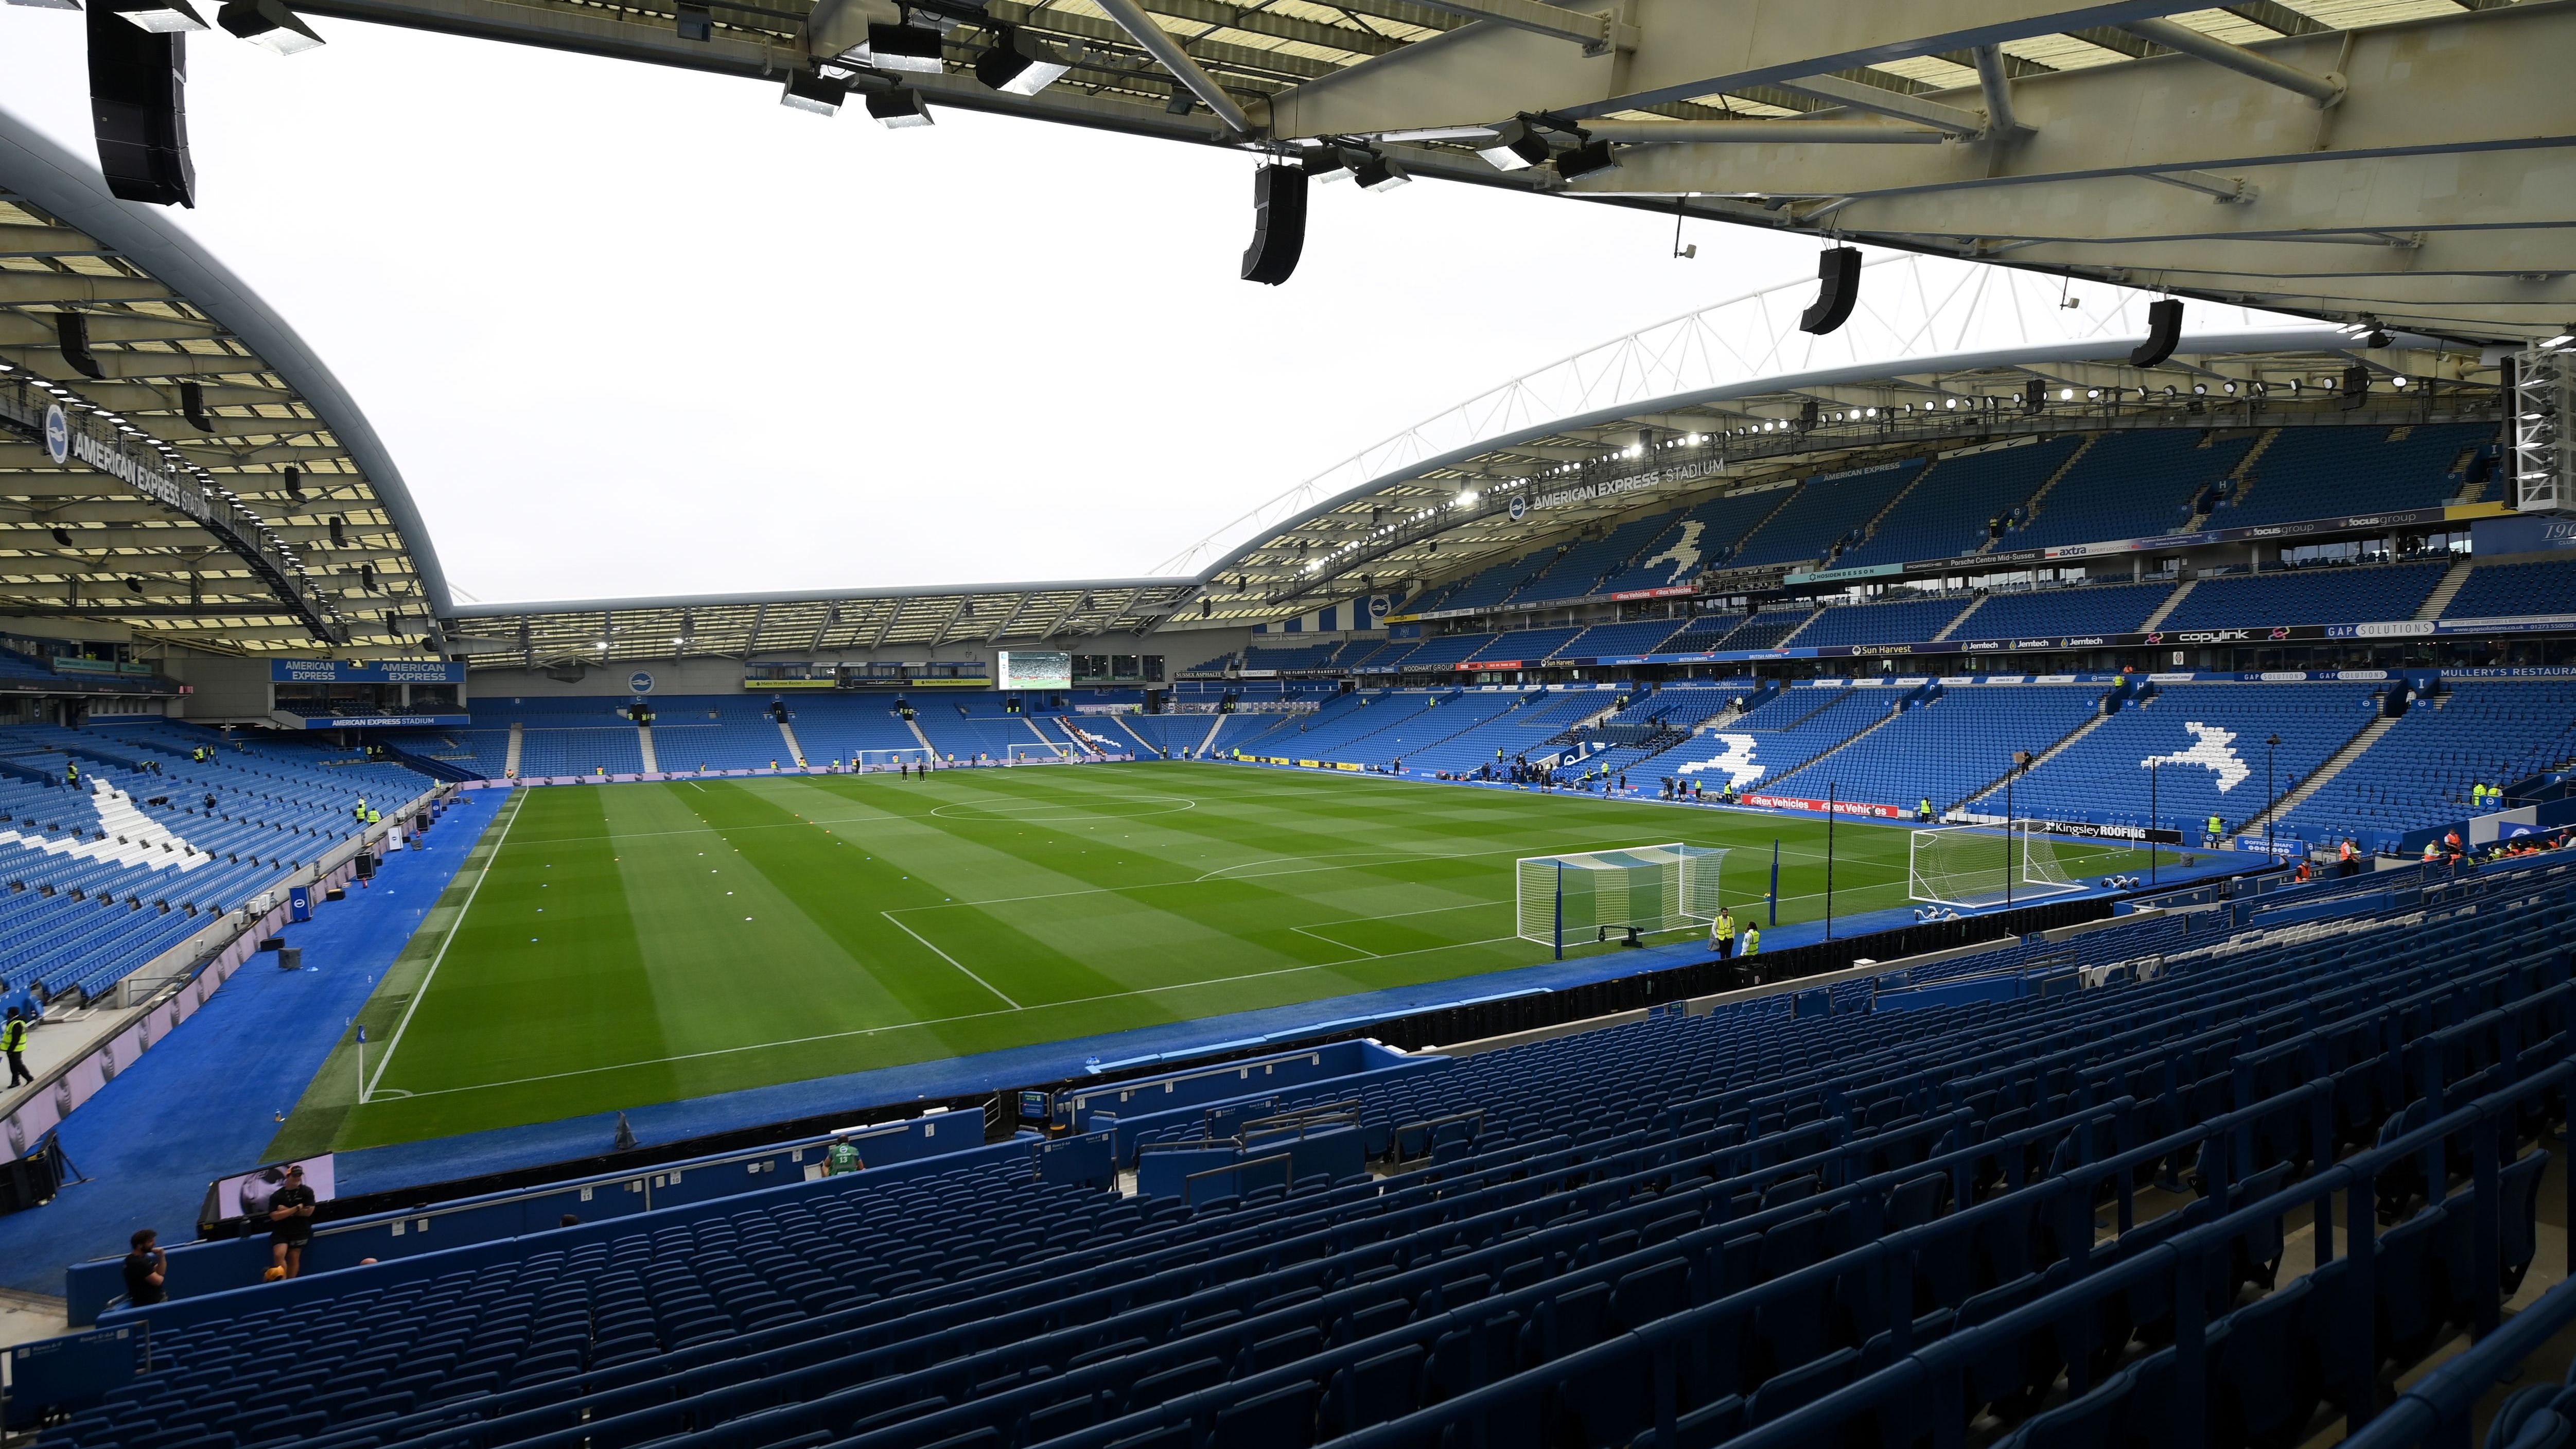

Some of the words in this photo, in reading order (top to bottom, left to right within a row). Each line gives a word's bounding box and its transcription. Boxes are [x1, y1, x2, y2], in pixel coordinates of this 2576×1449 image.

[1824, 469, 1862, 481] AMERICAN
[1864, 462, 1900, 474] EXPRESS
[74, 432, 135, 485] AMERICAN
[137, 465, 180, 507] EXPRESS
[182, 491, 210, 523] STADIUM
[1534, 485, 1596, 510] AMERICAN
[1598, 471, 1659, 496] EXPRESS
[1666, 458, 1724, 482] STADIUM
[2219, 481, 2226, 489] H
[2060, 546, 2086, 556] axtra
[1951, 558, 1974, 566] Porsche
[1997, 552, 2035, 561] Mid-Sussex
[2328, 626, 2352, 636] GAP
[2361, 623, 2429, 634] SOLUTIONS
[2179, 629, 2250, 642] copylink
[1969, 641, 1998, 650] Jemtech
[2070, 637, 2102, 645] Jemtech
[1879, 645, 1912, 653] Harvest
[286, 661, 334, 670] AMERICAN
[381, 664, 445, 672] AMERICAN
[292, 671, 335, 680] EXPRESS
[389, 672, 446, 680] EXPRESS
[2419, 678, 2424, 689] I
[1756, 796, 1772, 806] Rex
[1772, 797, 1809, 809] Vehicles
[1845, 804, 1886, 815] Vehices
[2056, 823, 2099, 837] Kingsley
[2100, 826, 2146, 839] ROOFING
[2244, 840, 2294, 848] @OFFICIABHAFC
